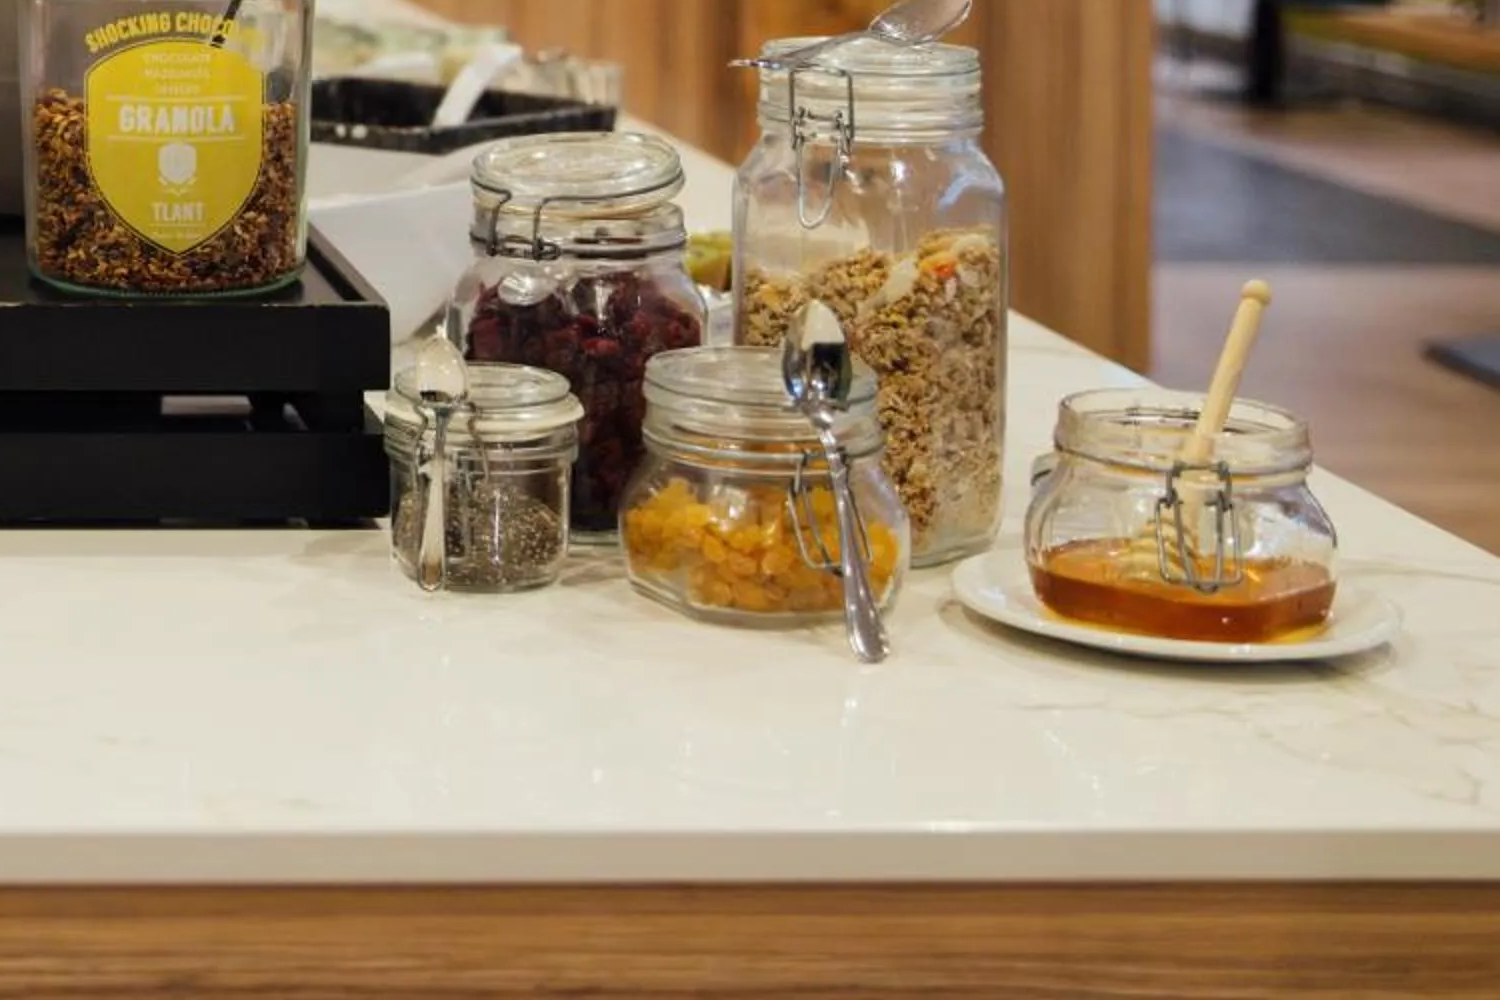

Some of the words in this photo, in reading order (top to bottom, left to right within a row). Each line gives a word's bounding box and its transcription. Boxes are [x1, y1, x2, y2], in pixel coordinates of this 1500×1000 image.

[85, 12, 171, 54] SHOCKING
[119, 104, 235, 134] GRANOLA
[152, 201, 205, 222] TLANT
